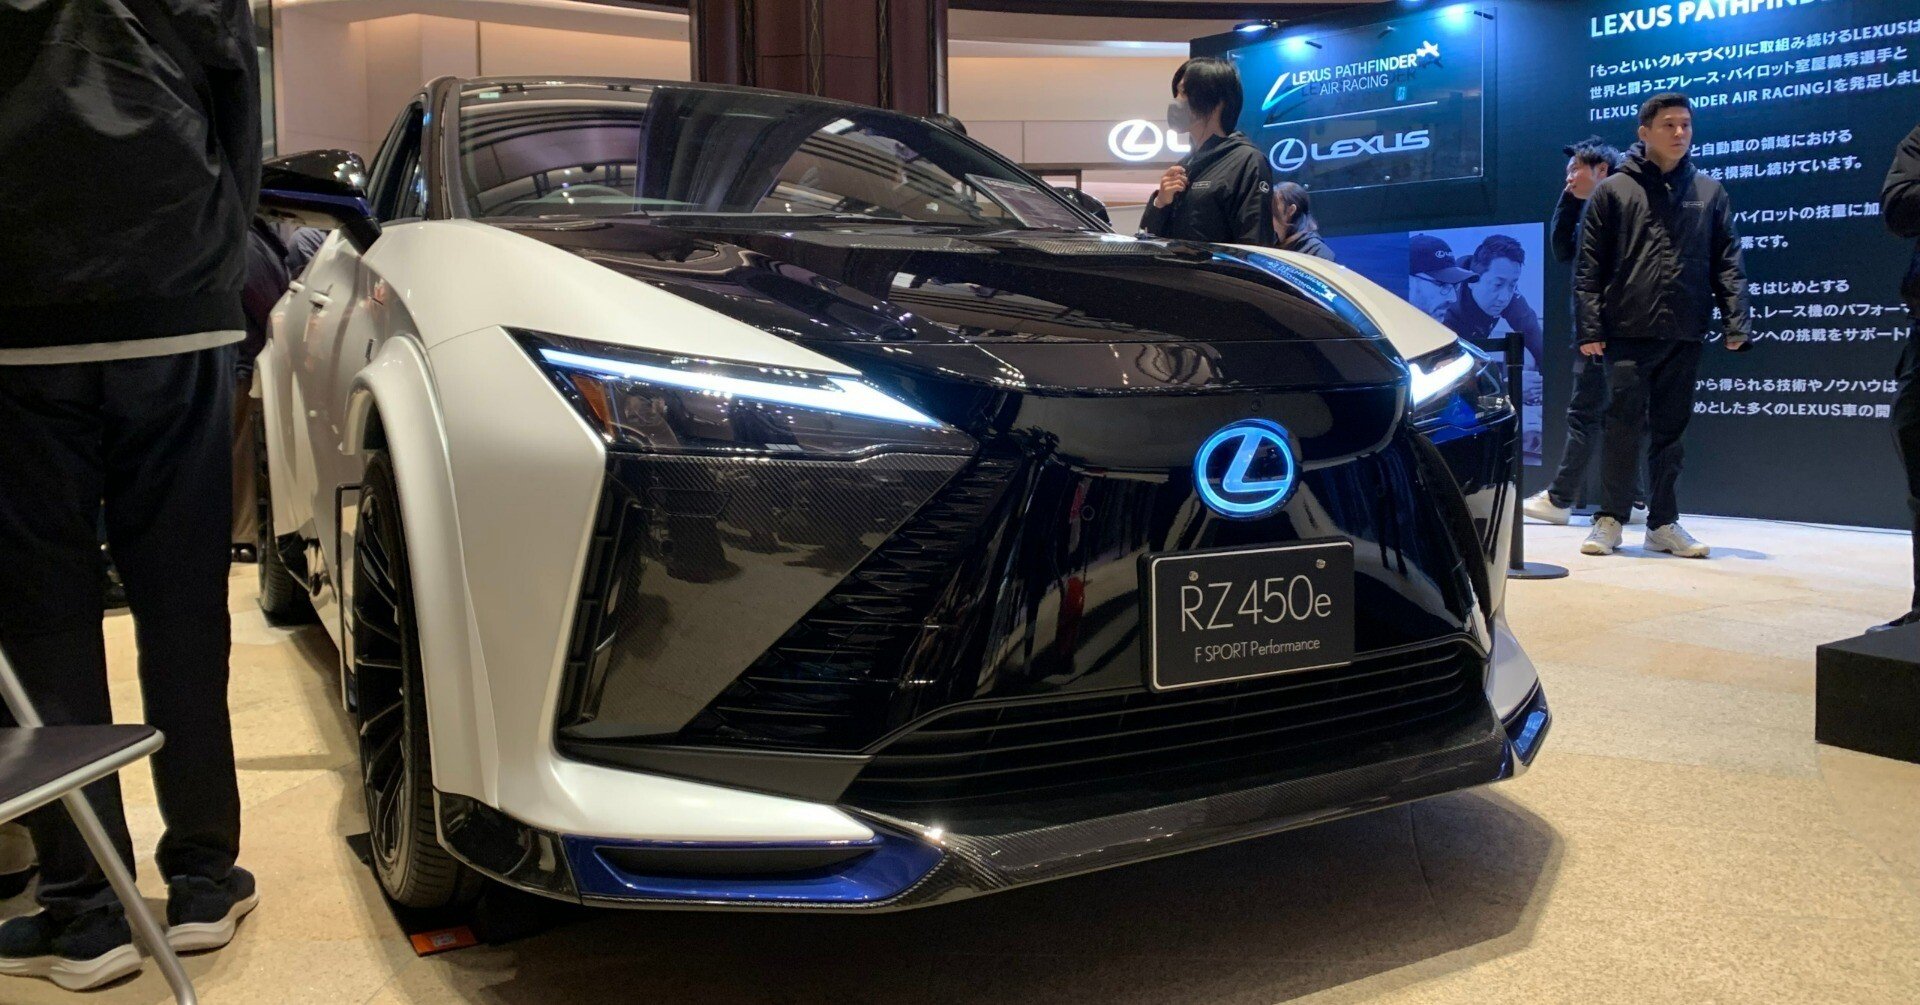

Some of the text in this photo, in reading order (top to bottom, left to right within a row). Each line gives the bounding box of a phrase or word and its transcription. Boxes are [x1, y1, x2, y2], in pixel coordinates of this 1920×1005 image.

[1590, 5, 1672, 38] LEXUS
[1292, 53, 1417, 86] LEXUS PATHFINDER
[1319, 74, 1388, 96] AIR RACING
[1732, 90, 1757, 103] AIR
[1311, 129, 1430, 161] LEXUS
[1194, 638, 1321, 663] F SPORT Performance
